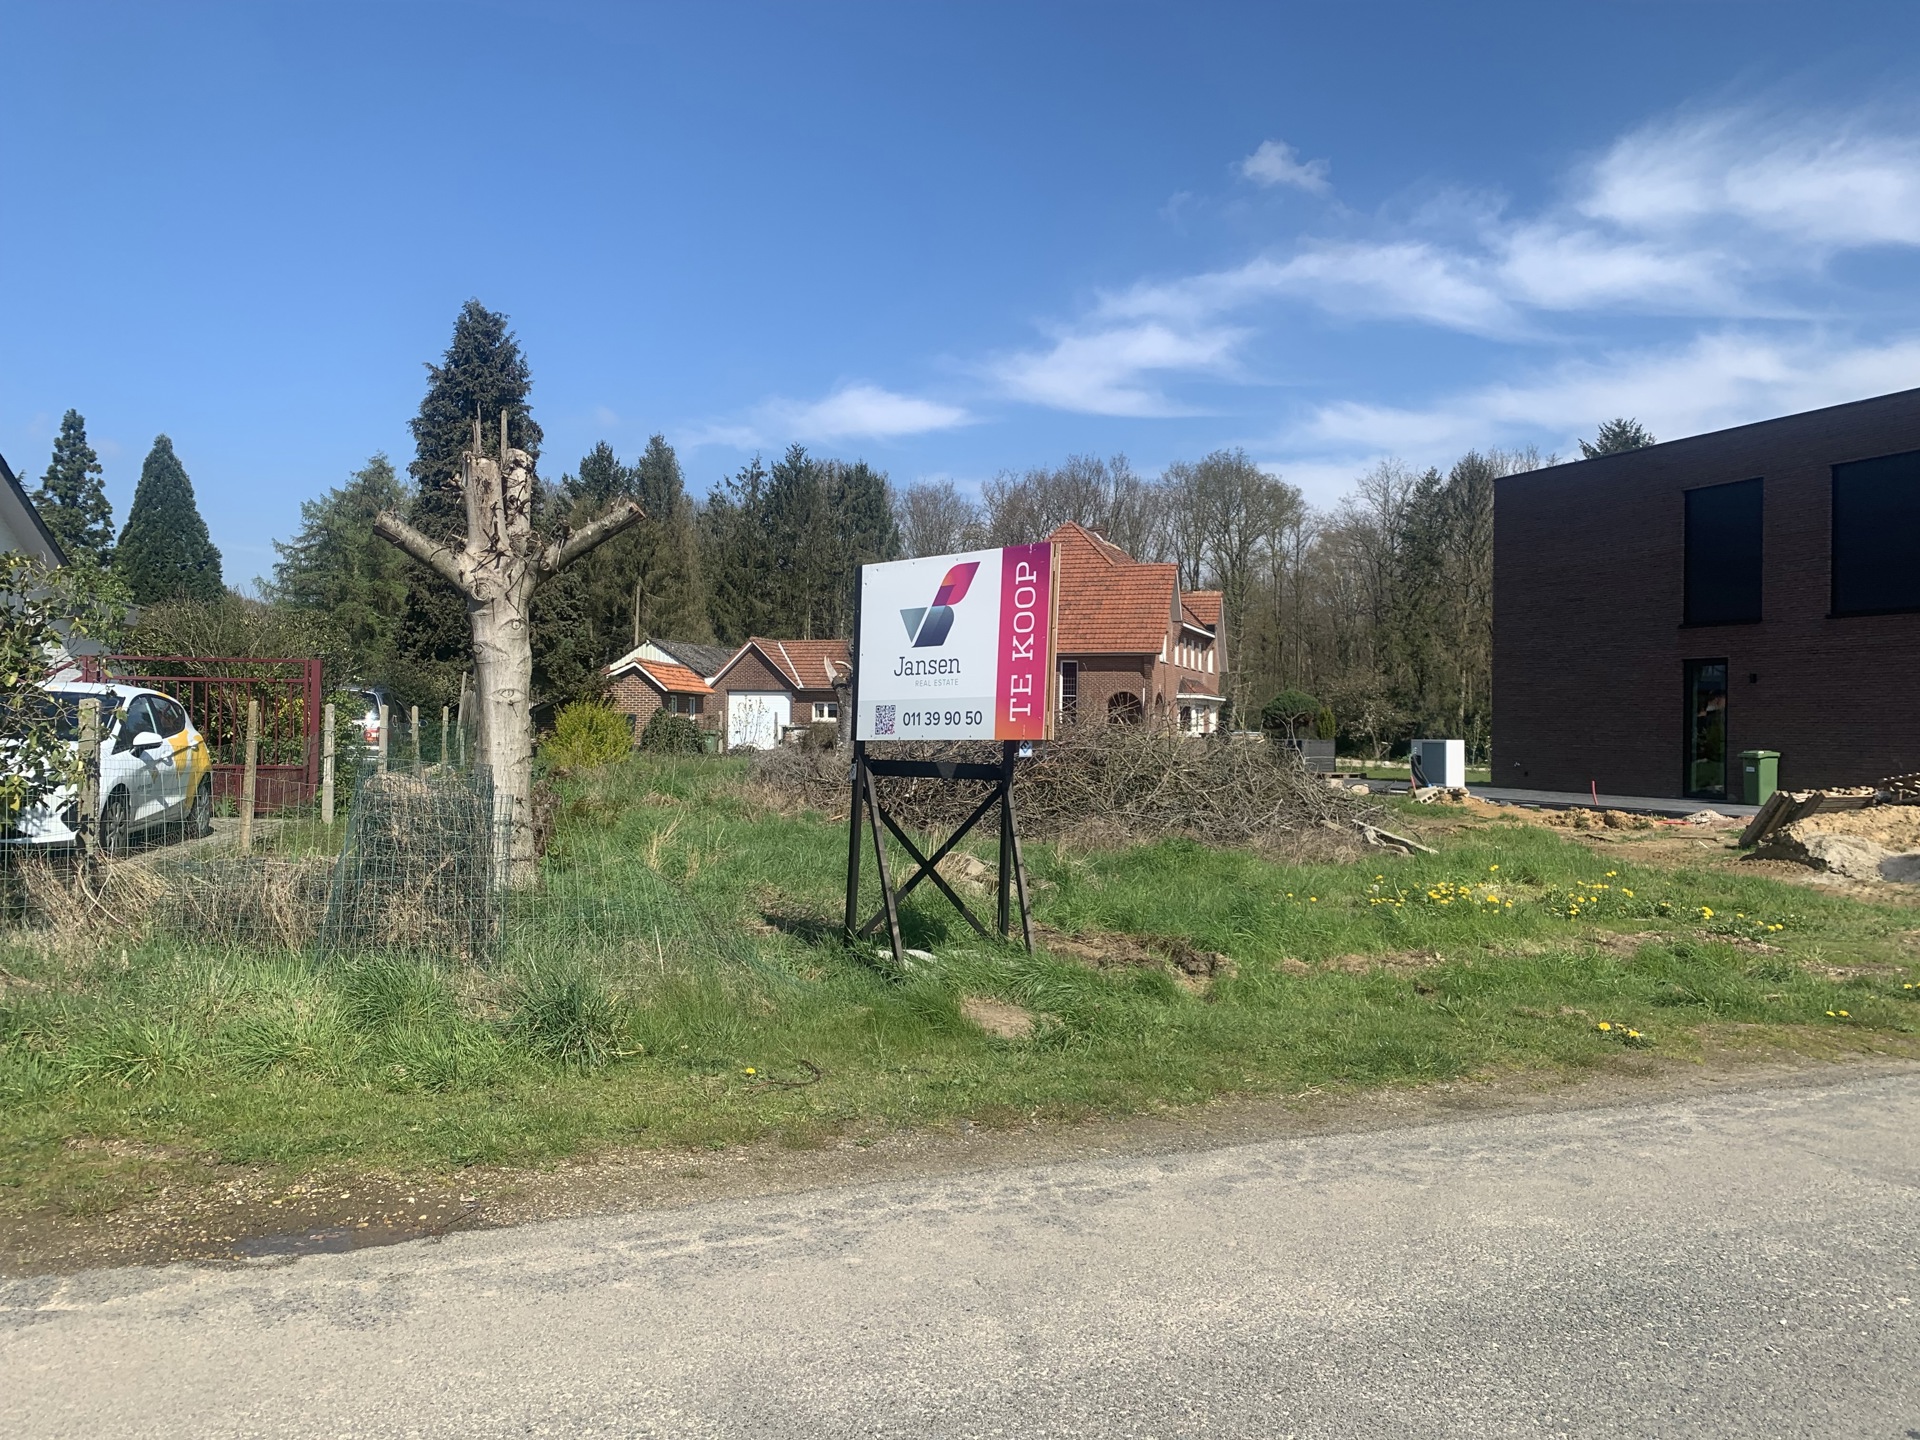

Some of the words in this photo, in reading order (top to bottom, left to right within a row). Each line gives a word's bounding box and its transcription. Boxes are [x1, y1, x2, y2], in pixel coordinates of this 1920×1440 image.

[1012, 561, 1037, 661] KOOP
[893, 656, 961, 676] Jansen
[915, 679, 931, 687] REAL
[934, 678, 959, 686] ESTATE
[1009, 674, 1032, 722] TE
[902, 712, 920, 726] 011
[924, 711, 940, 726] 39
[944, 711, 961, 725] 90
[965, 710, 983, 725] 50
